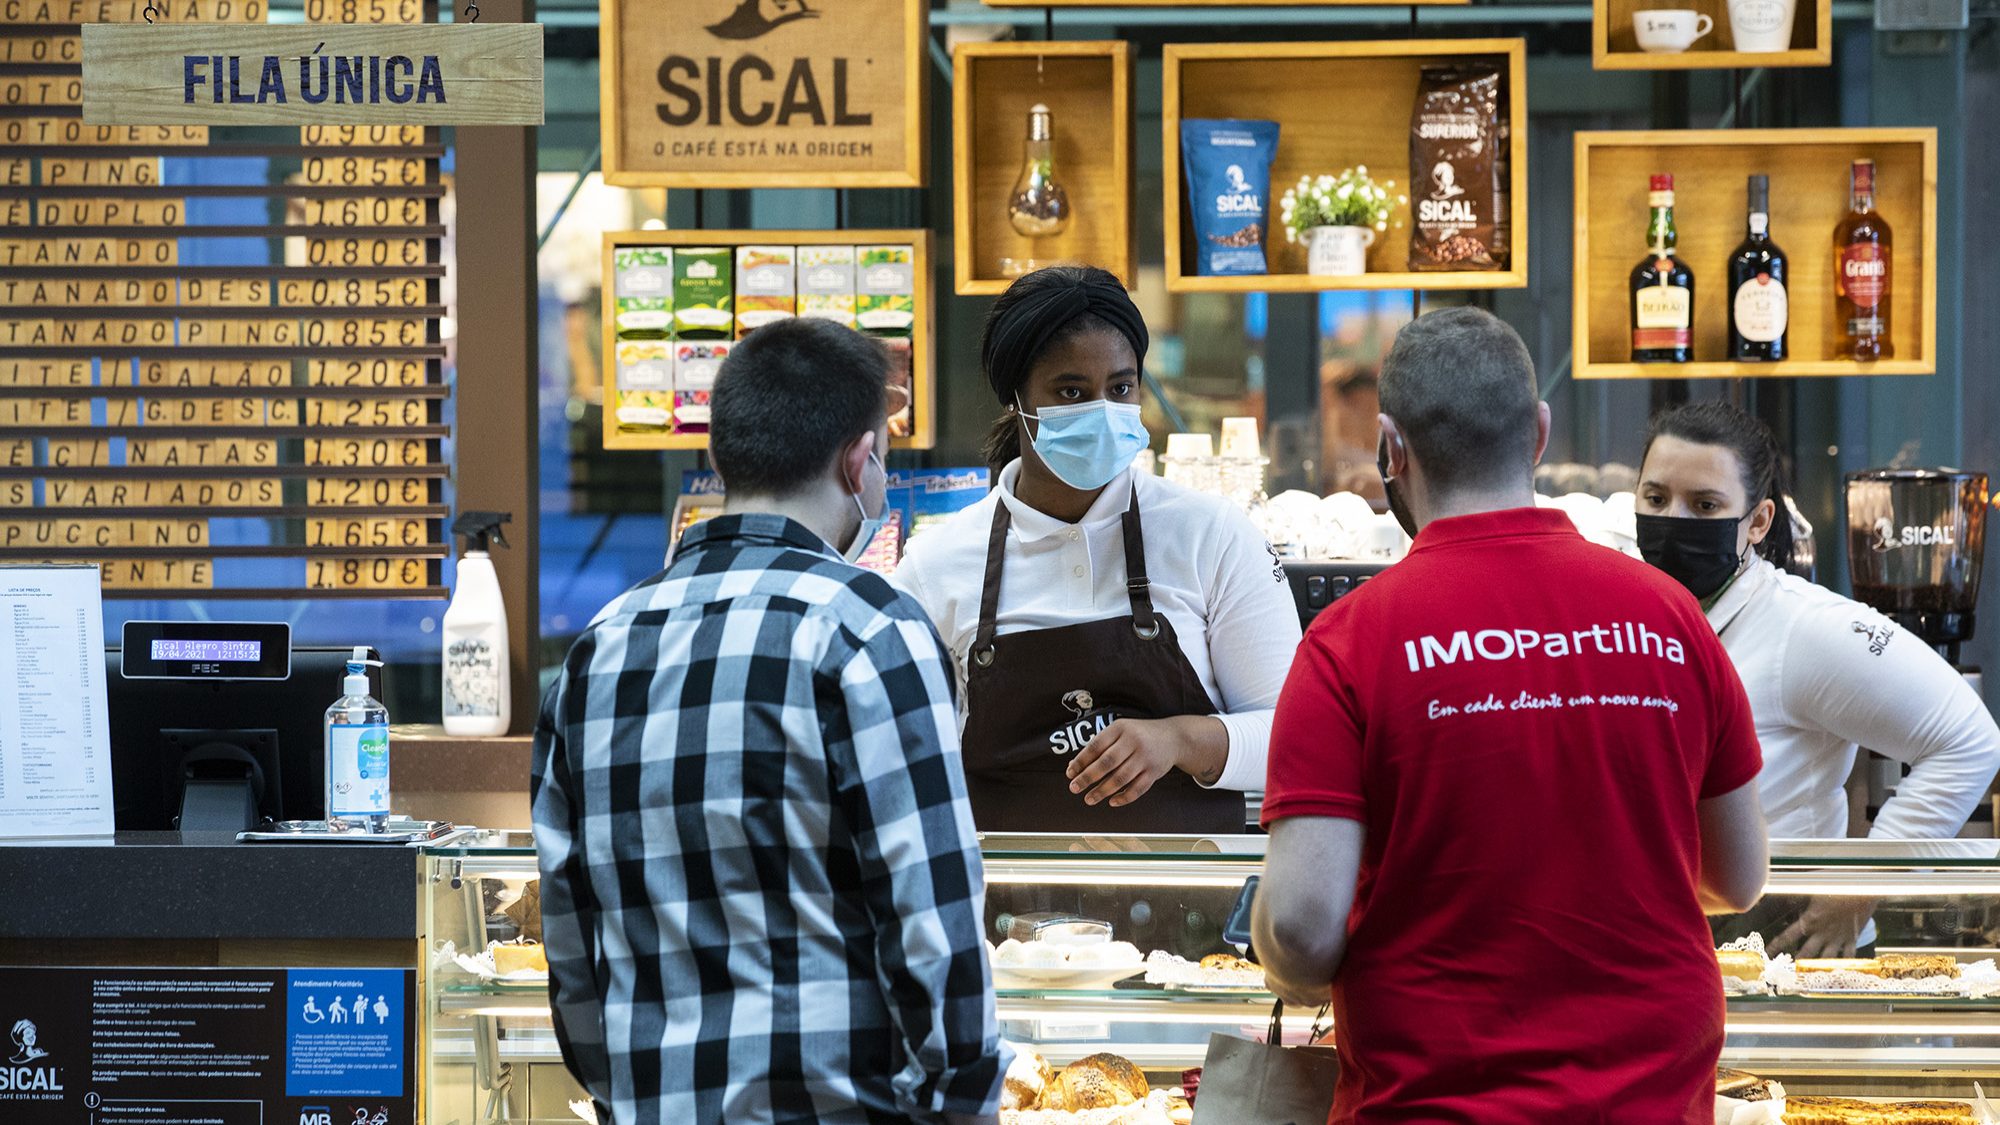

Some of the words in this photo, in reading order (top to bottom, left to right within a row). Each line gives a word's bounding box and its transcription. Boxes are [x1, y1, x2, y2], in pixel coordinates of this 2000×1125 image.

[5, 0, 260, 22] CAFEINADO
[308, 0, 416, 23] 0.85€
[184, 56, 288, 103] FILA
[300, 42, 446, 103] ÚNICA
[656, 54, 872, 126] SICAL
[306, 125, 416, 145] 0.90€
[1420, 122, 1479, 139] SUPERIOR
[655, 141, 665, 157] O
[672, 138, 717, 157] CAFÉ
[724, 138, 768, 157] ESTÁ
[775, 141, 799, 157] NA
[806, 141, 873, 157] ORIGEM
[8, 157, 22, 184] É
[51, 162, 155, 184] PING.
[308, 158, 418, 185] 0.85€
[7, 199, 21, 225] É
[45, 203, 177, 226] DUPLO
[315, 199, 418, 227] 1.60€
[1216, 194, 1263, 212] SICAL
[1419, 199, 1477, 221] SICAL
[8, 240, 170, 266] TANADO
[310, 239, 418, 265] 0.80€
[312, 279, 418, 305] 0.85€
[307, 320, 417, 346] 0.85€
[13, 363, 84, 385] ITE
[148, 361, 282, 387] GALÃO
[317, 359, 417, 387] 1.20€
[14, 400, 81, 422] ITE
[315, 399, 419, 427] 1.25€
[10, 438, 24, 467] É
[131, 442, 268, 466] NATAS
[311, 439, 419, 467] 1.30€
[10, 483, 24, 505] S
[53, 480, 273, 507] VARIADOS
[315, 477, 419, 504] 1.20€
[6, 522, 201, 547] PUCCINO
[313, 520, 419, 546] 1.65€
[1901, 525, 1954, 546] SICAL
[72, 560, 208, 584] ENTE
[312, 558, 419, 588] 1.80€
[152, 651, 206, 659] 19/04/2021
[217, 651, 260, 659] 12:15:23
[153, 641, 179, 650] Sical
[223, 641, 255, 650] Sintra
[1868, 628, 1894, 657] SICAL
[1428, 700, 1459, 720] Em
[1464, 694, 1505, 715] cada
[1510, 691, 1563, 710] cliente
[1568, 694, 1595, 707] um
[1598, 694, 1640, 707] novo
[0, 1066, 63, 1091] SICAL
[16, 1092, 30, 1100] ESTÁ
